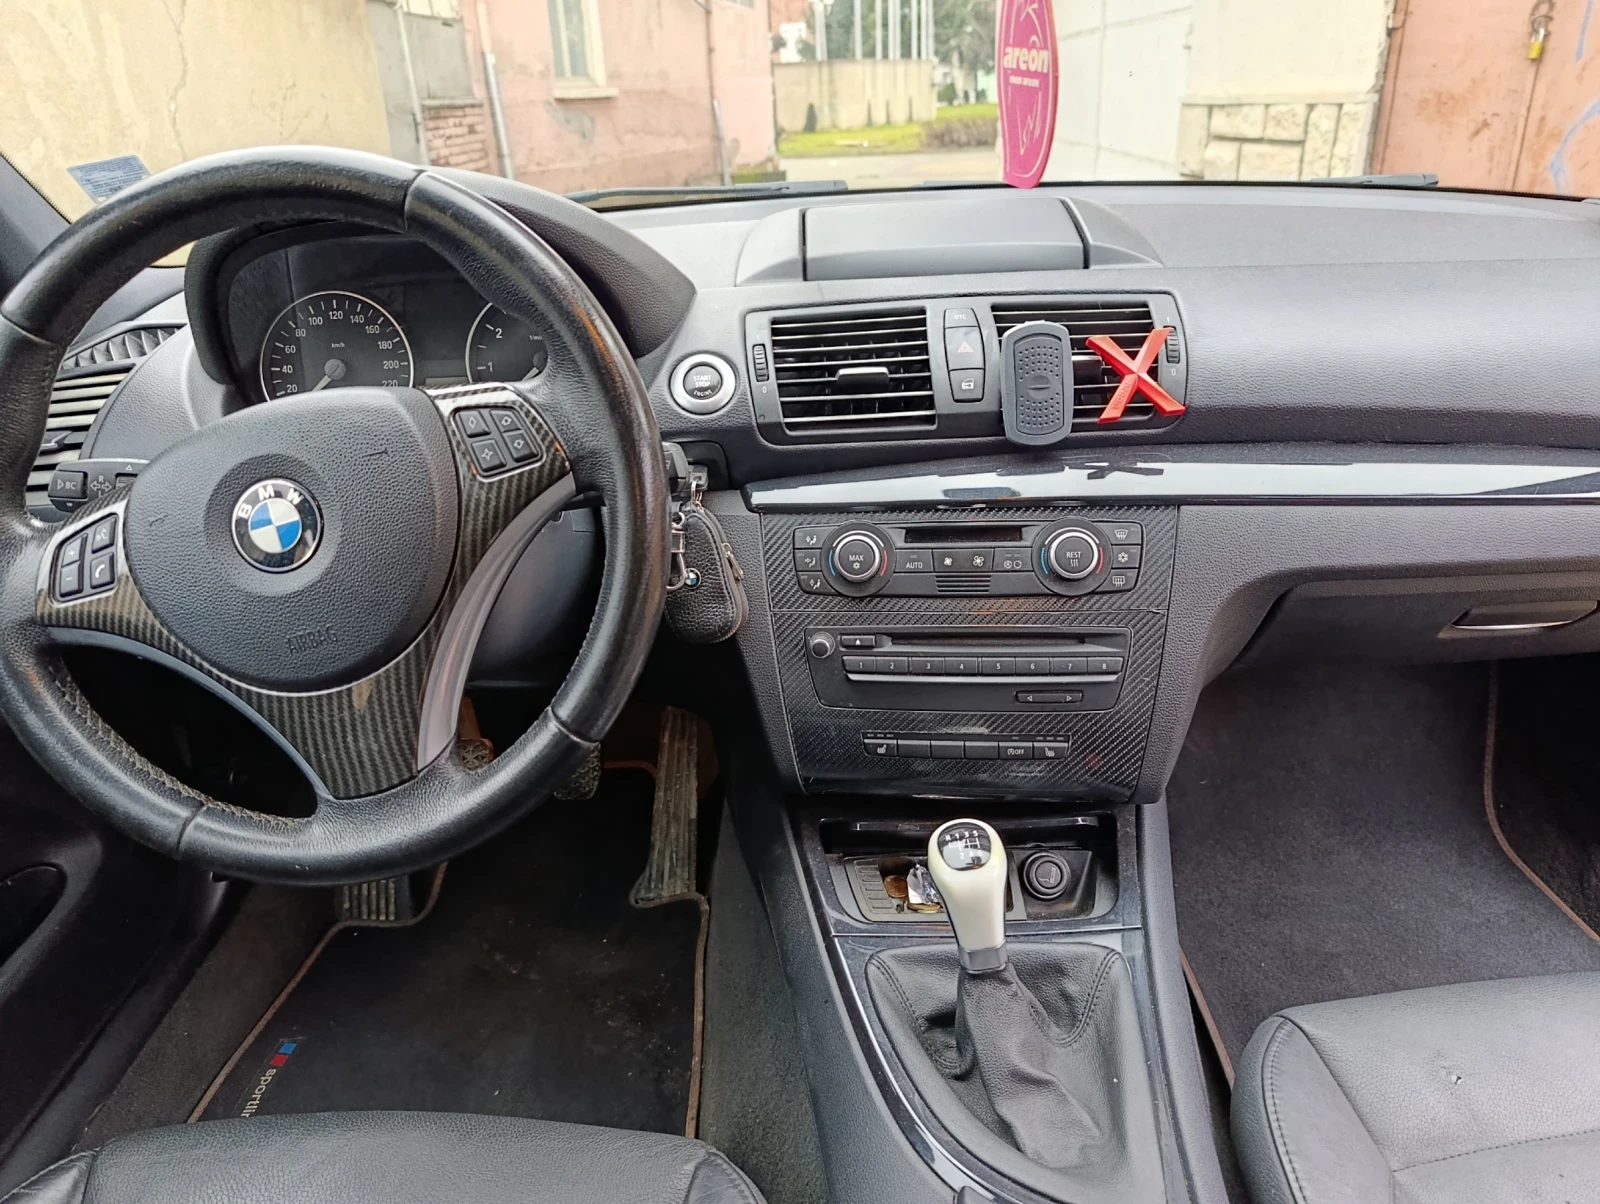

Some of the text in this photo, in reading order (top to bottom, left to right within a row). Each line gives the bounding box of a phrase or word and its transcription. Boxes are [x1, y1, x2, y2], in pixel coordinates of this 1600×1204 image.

[1004, 46, 1048, 73] areon
[329, 310, 344, 320] 120
[350, 314, 364, 324] 140
[308, 316, 323, 326] 100
[295, 328, 306, 338] 80
[365, 324, 380, 334] 160
[495, 328, 503, 338] 2
[331, 340, 346, 348] km/h
[378, 340, 392, 350] 180
[285, 345, 296, 354] 60
[282, 365, 294, 374] 40
[383, 360, 400, 370] 200
[487, 362, 493, 372] 1
[286, 384, 298, 393] 20
[66, 482, 76, 490] BC
[238, 484, 304, 519] BMW
[849, 554, 864, 562] MAX
[1066, 551, 1082, 560] REST
[906, 561, 923, 569] AUTO
[286, 625, 339, 654] AIRBAG
